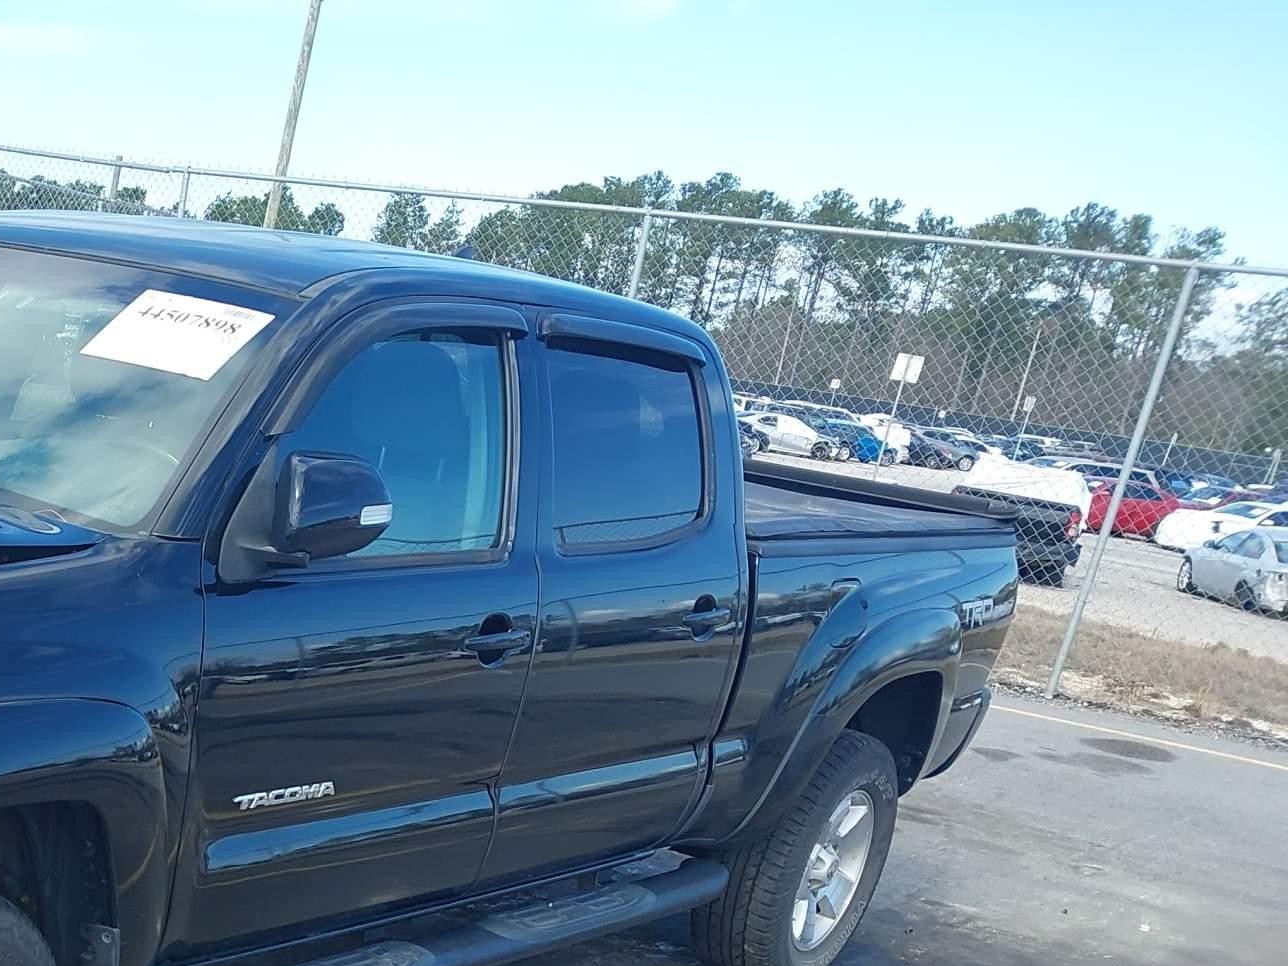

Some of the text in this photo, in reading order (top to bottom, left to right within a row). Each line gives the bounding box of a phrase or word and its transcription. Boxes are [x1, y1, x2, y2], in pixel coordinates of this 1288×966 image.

[138, 305, 242, 335] 44507898
[962, 599, 993, 628] TRD
[232, 781, 335, 810] TACOMA
